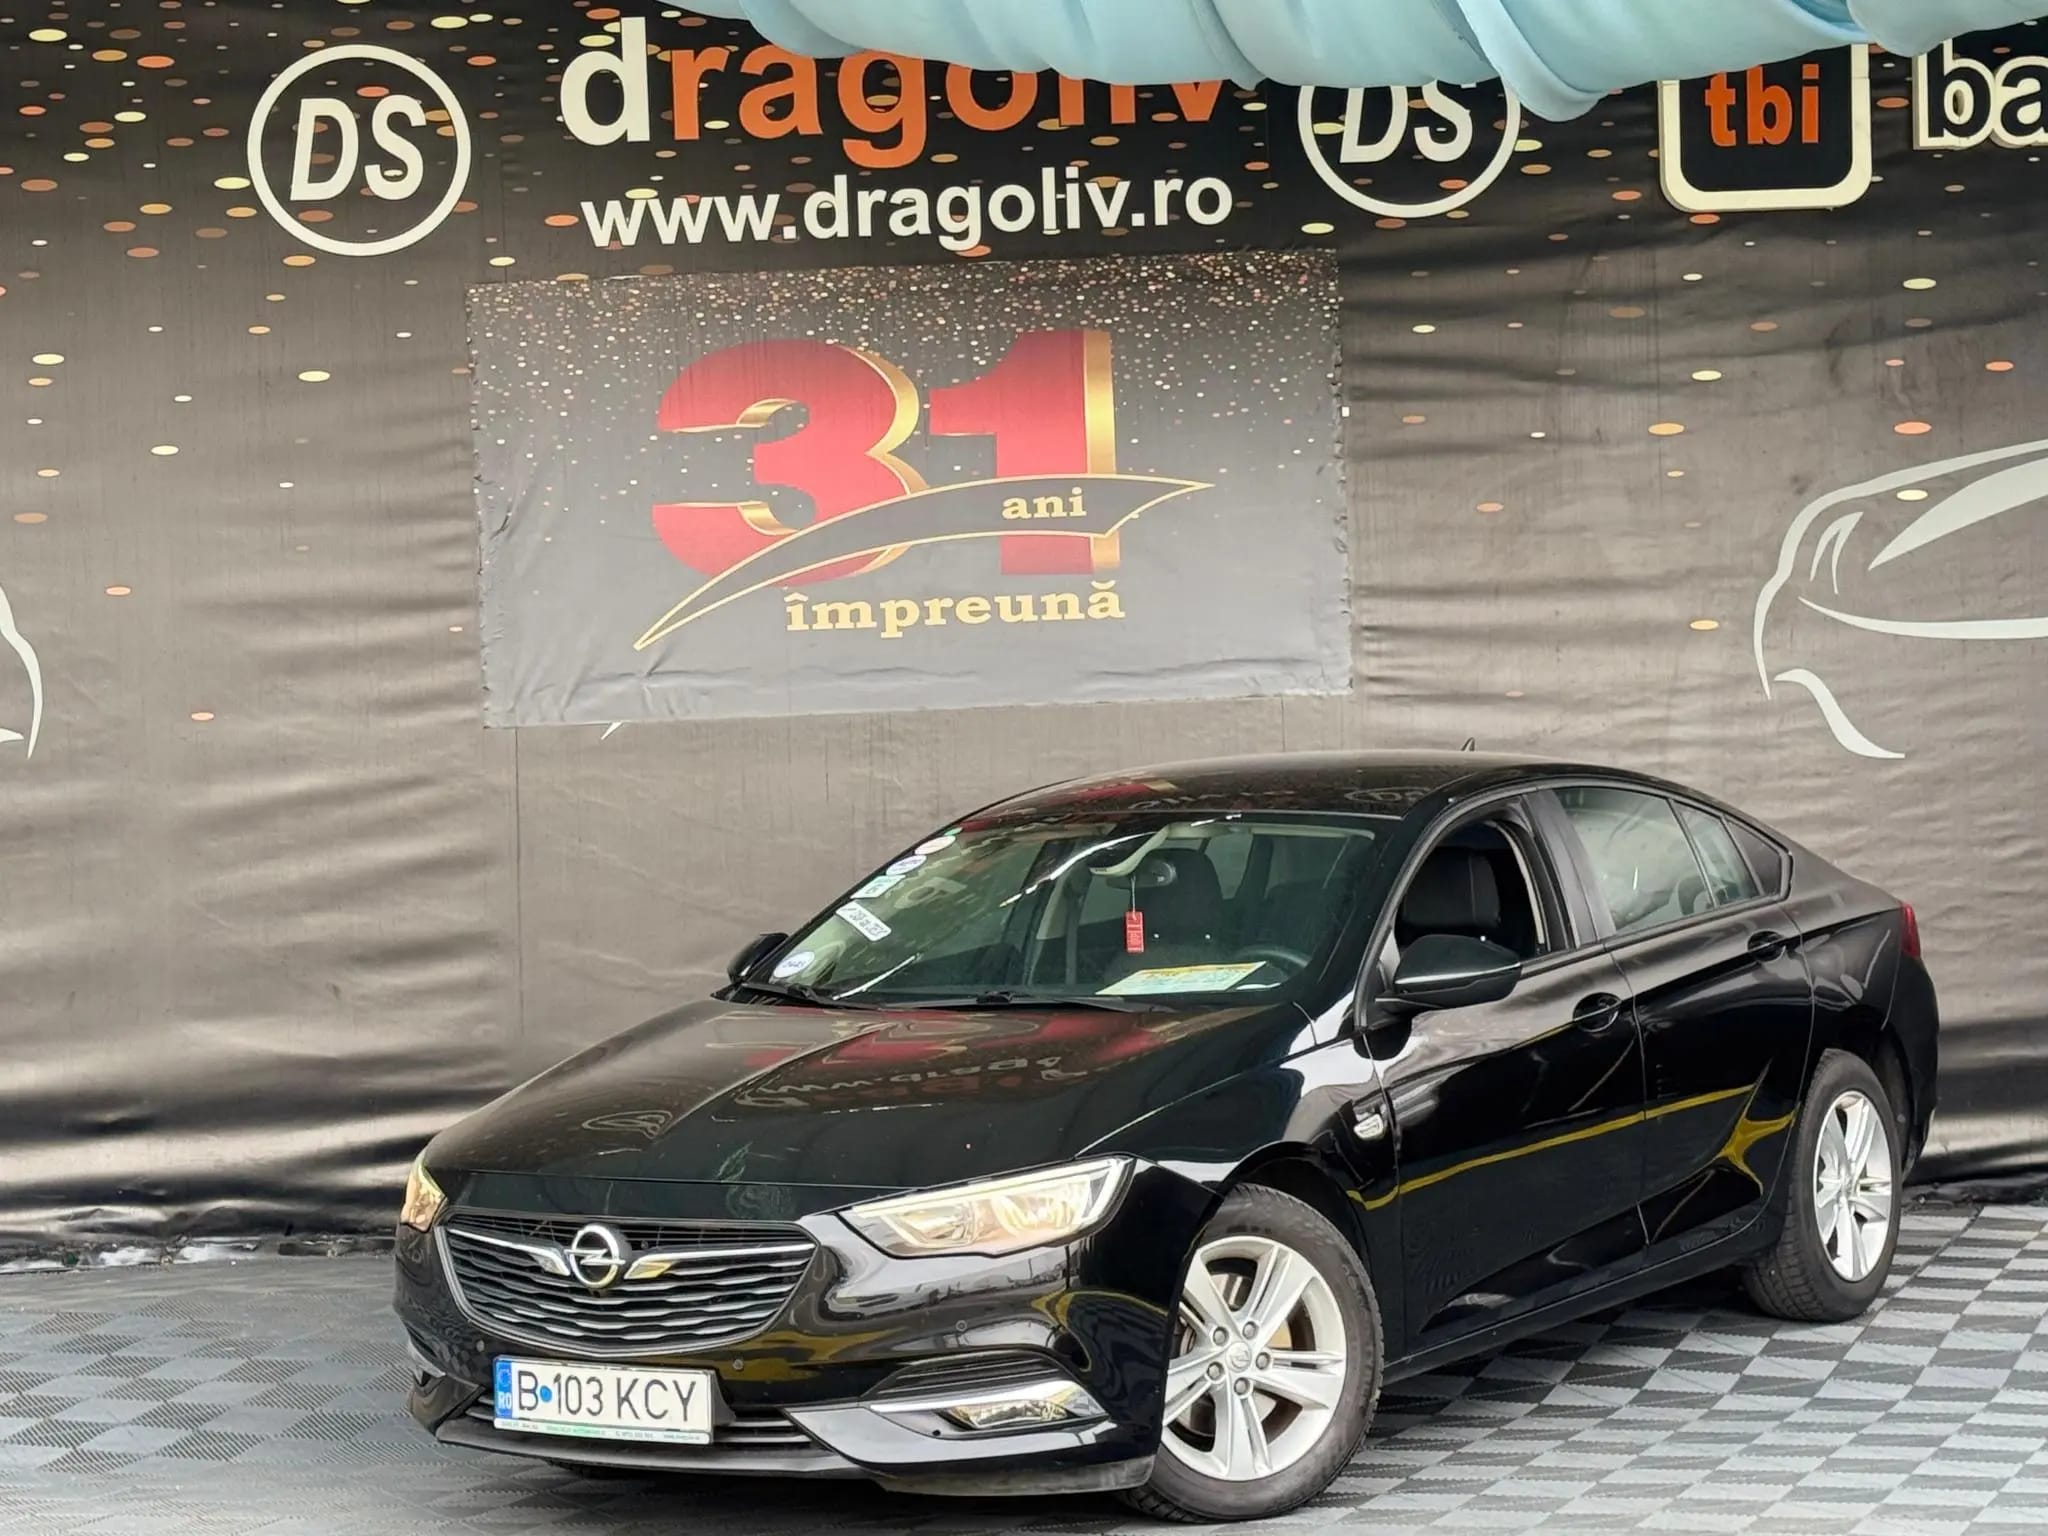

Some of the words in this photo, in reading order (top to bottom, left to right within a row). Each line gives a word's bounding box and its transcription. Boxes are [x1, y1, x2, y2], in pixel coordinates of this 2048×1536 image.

[1704, 63, 1820, 147] tbi
[290, 94, 427, 201] DS
[580, 166, 1233, 253] www.dragoliv.ro
[652, 330, 1122, 587] 31
[1002, 487, 1088, 520] ani
[785, 579, 1125, 638] împreună
[518, 1370, 539, 1411] B
[553, 1373, 604, 1417] 103
[616, 1377, 697, 1422] KCY
